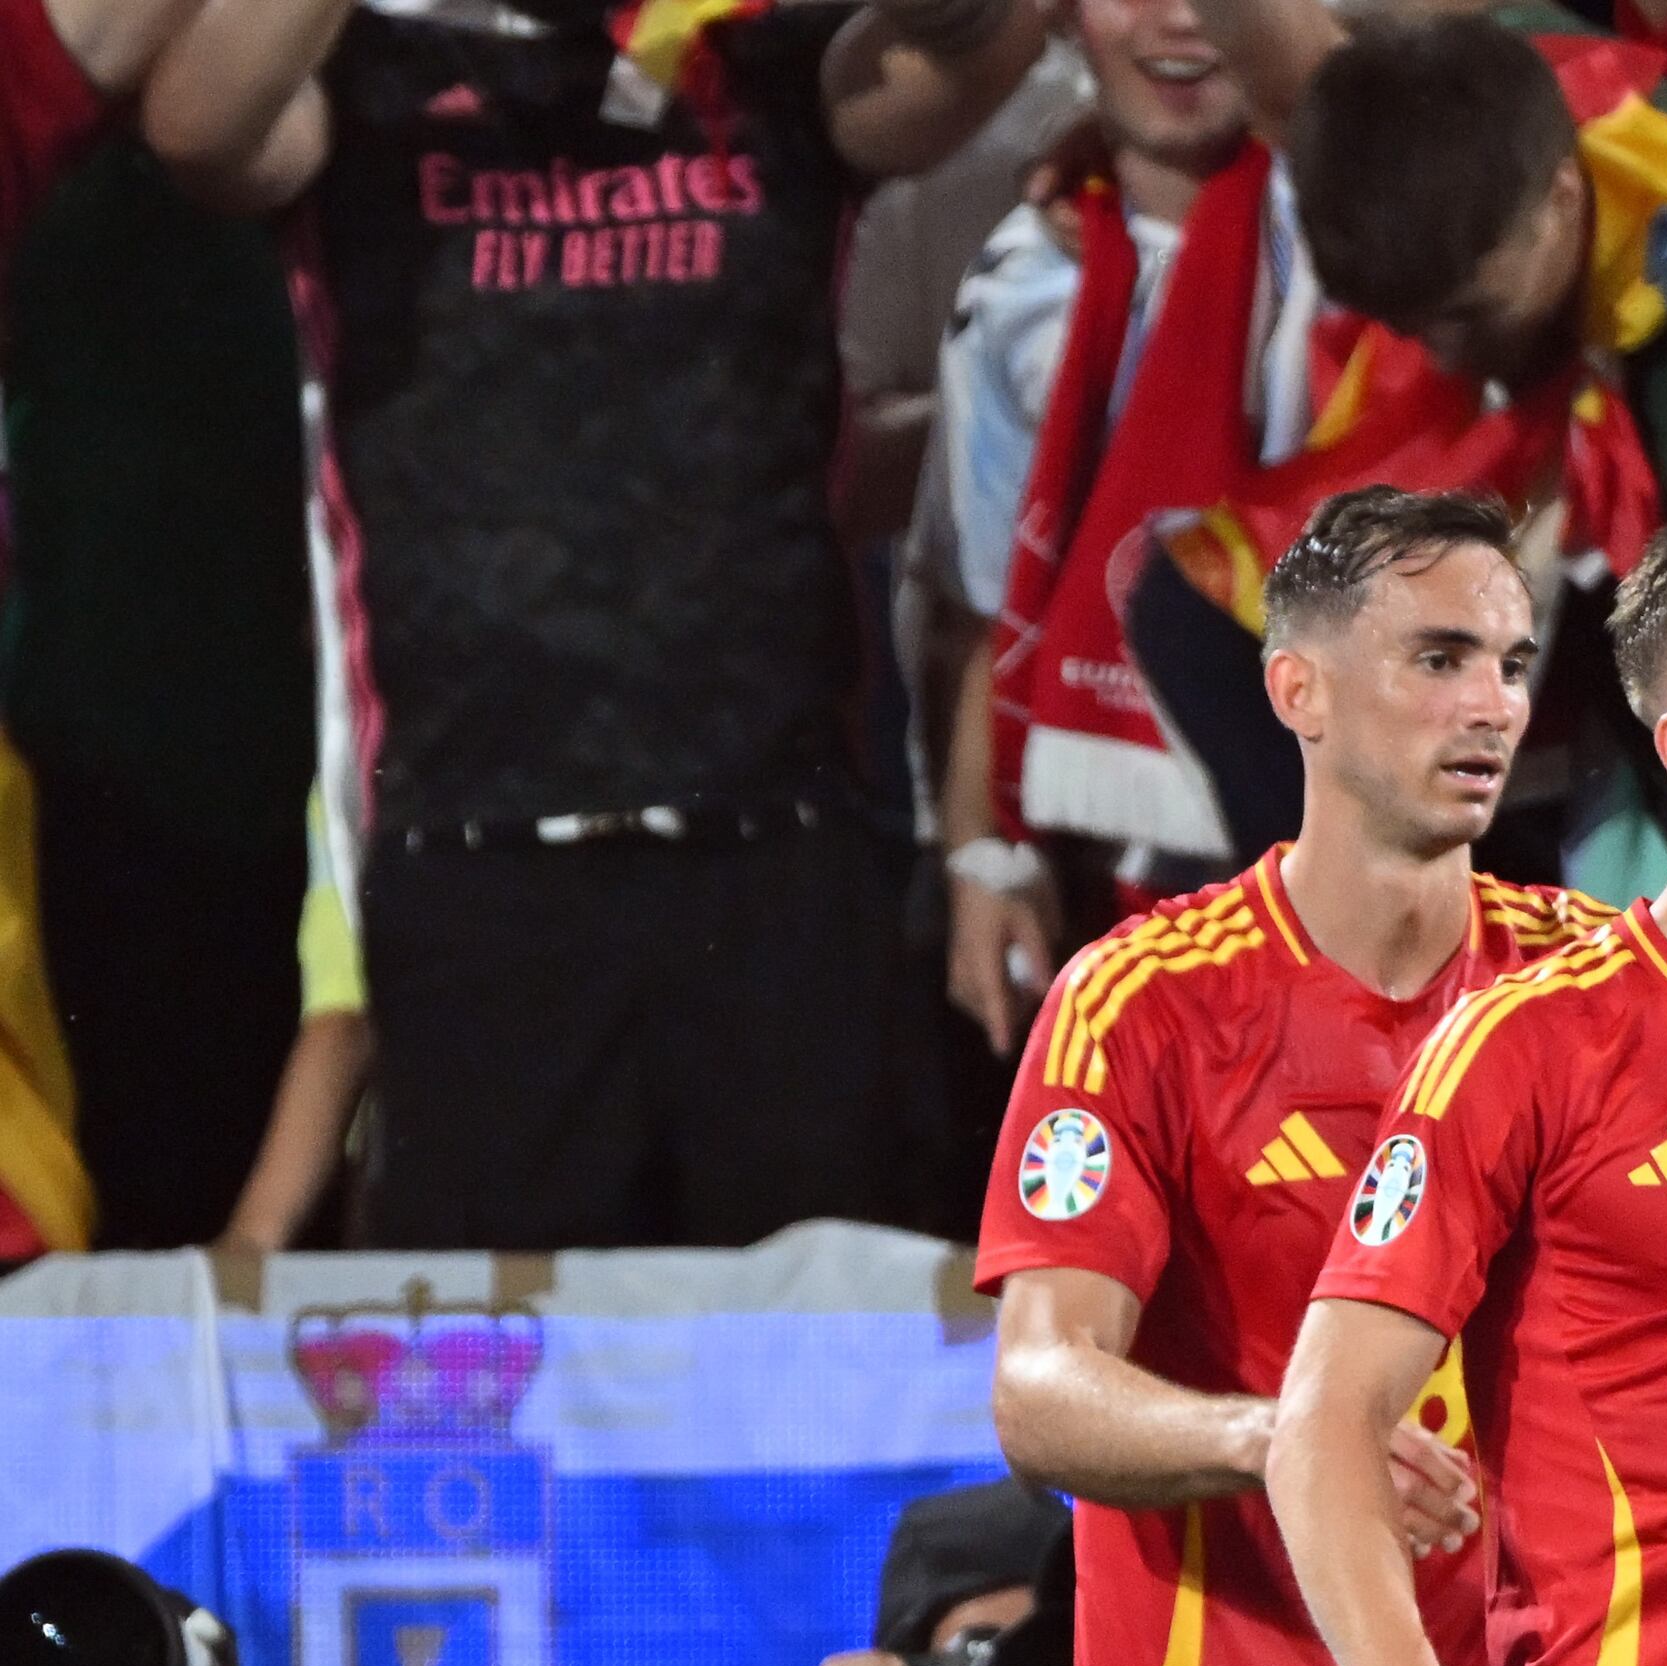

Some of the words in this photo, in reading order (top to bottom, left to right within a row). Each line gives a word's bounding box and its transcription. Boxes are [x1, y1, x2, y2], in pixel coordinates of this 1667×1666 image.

[419, 153, 762, 225] Emirates
[471, 228, 549, 290] FLY
[560, 219, 723, 287] BETTER
